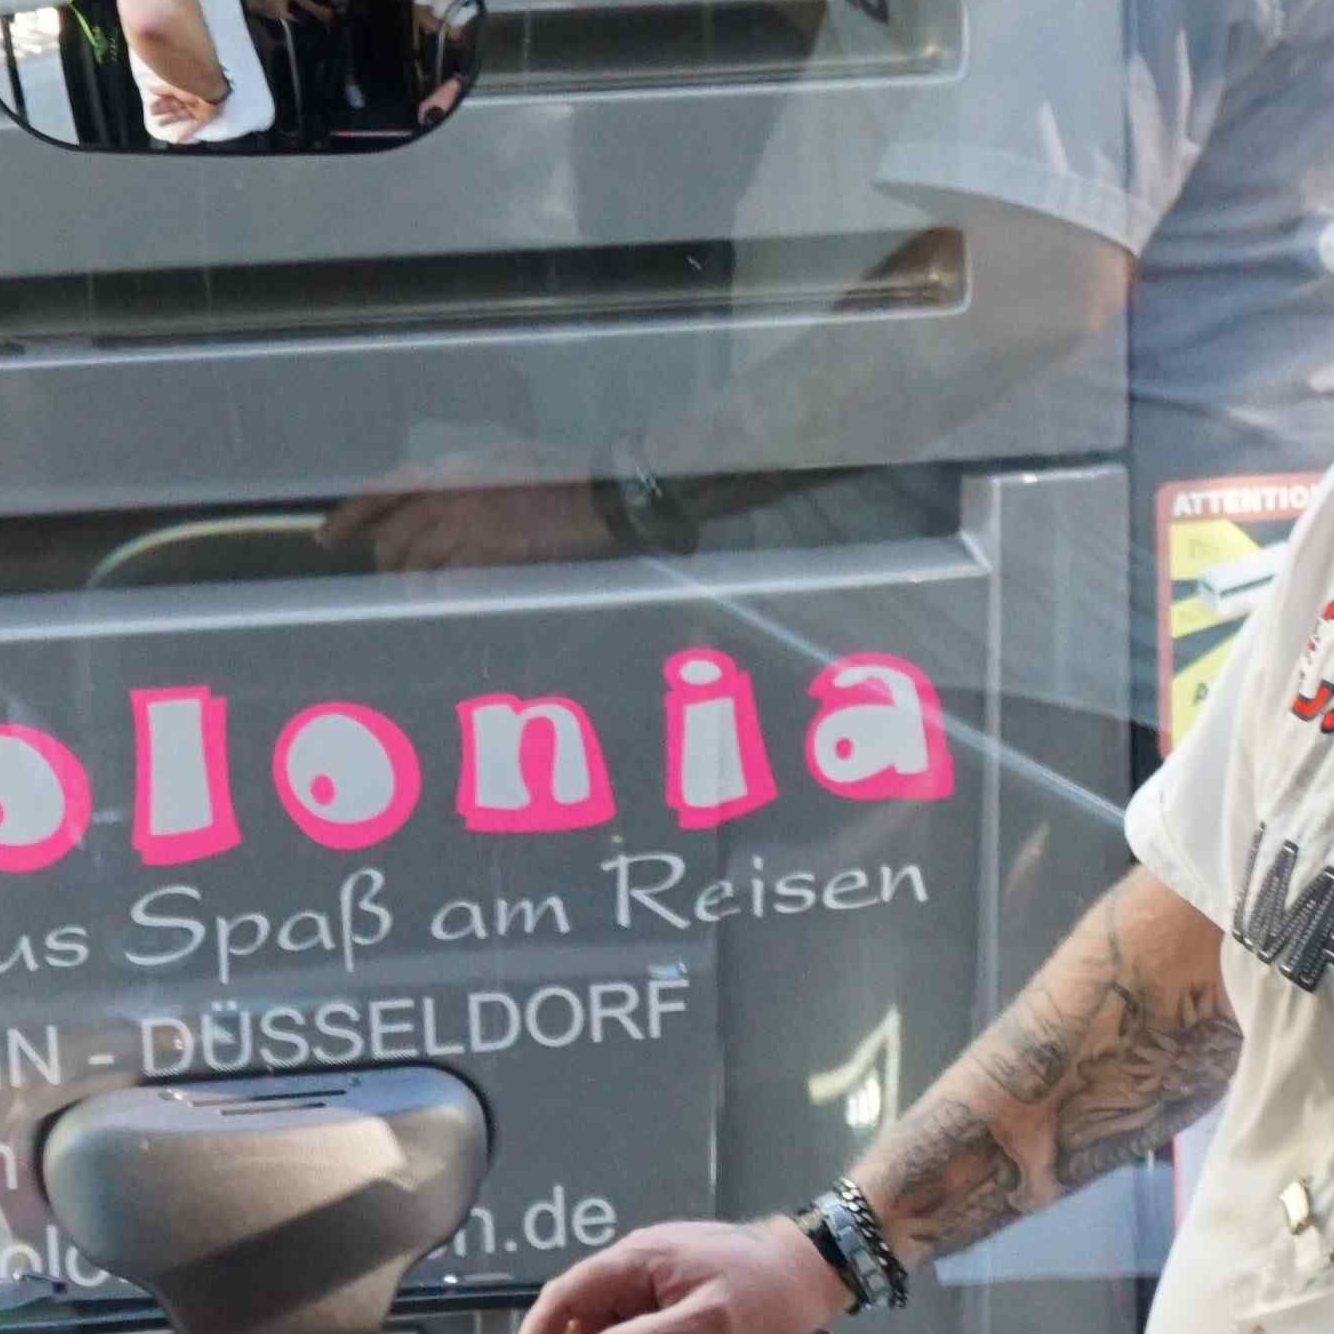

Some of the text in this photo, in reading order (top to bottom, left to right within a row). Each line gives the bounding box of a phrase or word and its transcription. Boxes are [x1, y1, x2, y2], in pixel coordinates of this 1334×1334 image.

[1172, 483, 1321, 517] ATTENTIO
[124, 867, 394, 986] Spaß
[430, 895, 571, 940] am
[599, 851, 930, 930] Reisen
[140, 978, 691, 1078] DÜSSELDORF
